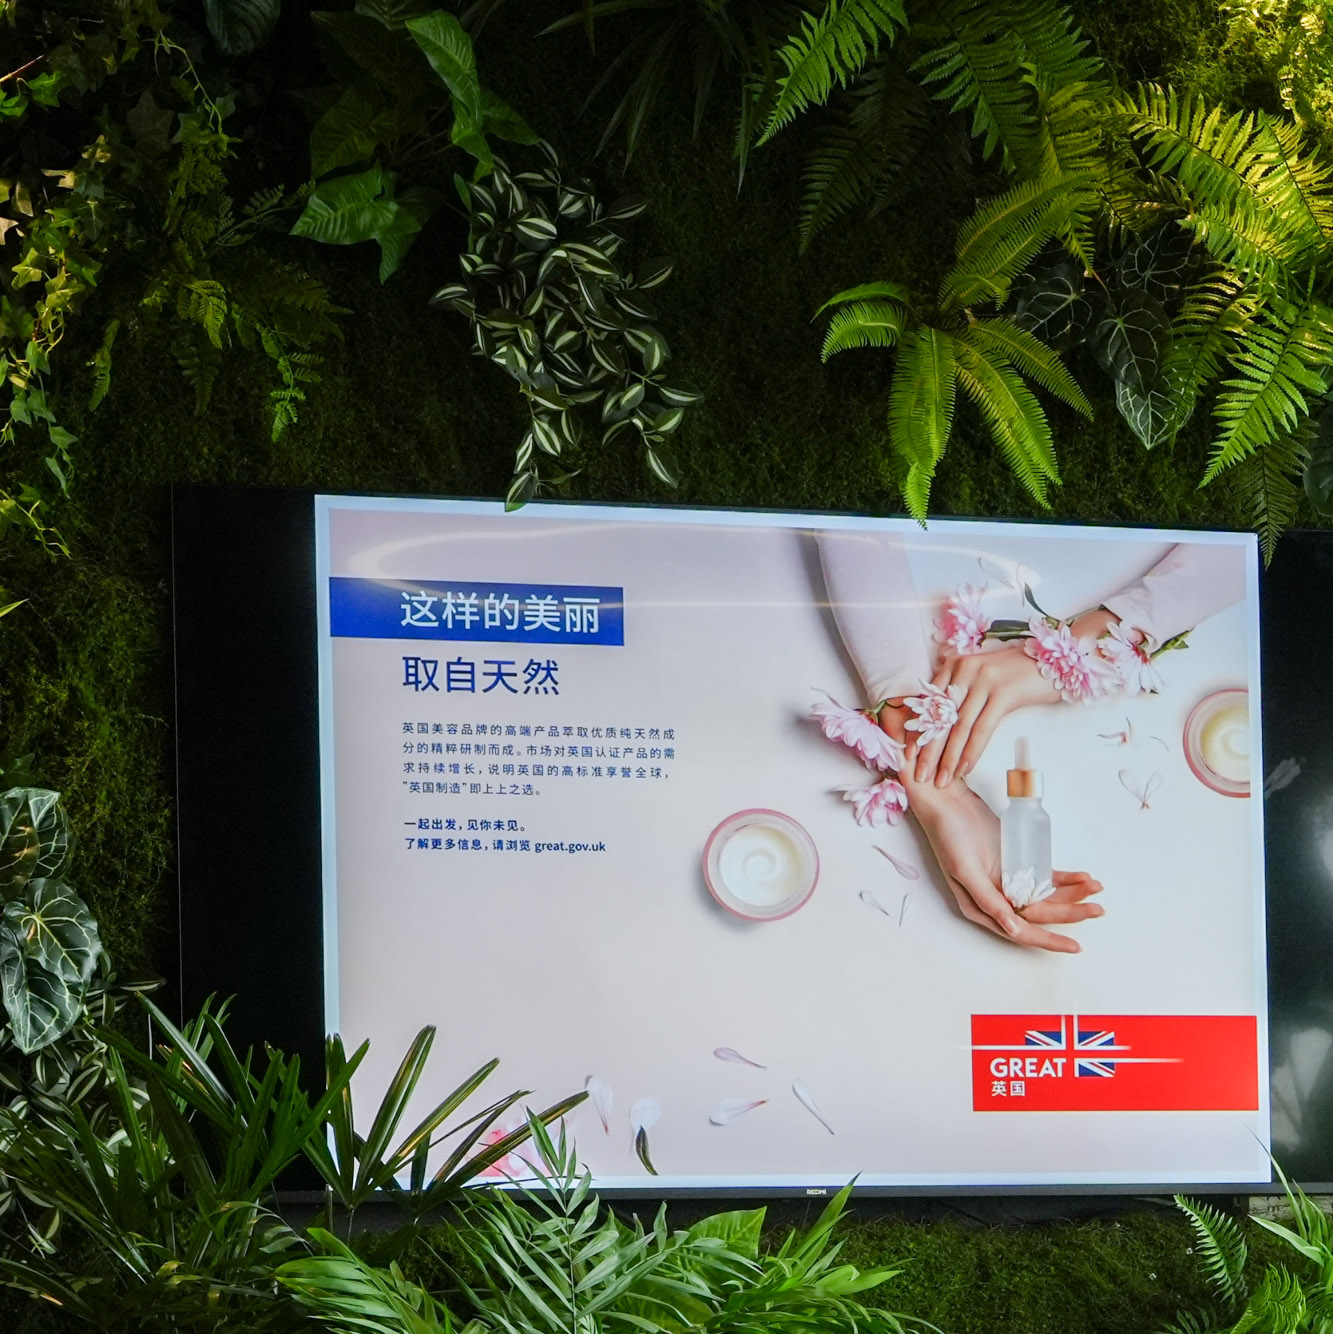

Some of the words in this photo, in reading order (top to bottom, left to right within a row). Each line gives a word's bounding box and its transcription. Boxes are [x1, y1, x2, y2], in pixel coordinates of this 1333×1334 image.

[400, 591, 600, 633] 这样的美丽
[402, 657, 560, 696] 取自天然
[404, 819, 526, 832] 一起出发，见你未见。
[405, 838, 531, 852] 了解更多信息，请浏览
[535, 841, 606, 854] great.gov.uk
[990, 1057, 1067, 1078] GREAT
[991, 1081, 1025, 1097] 英国
